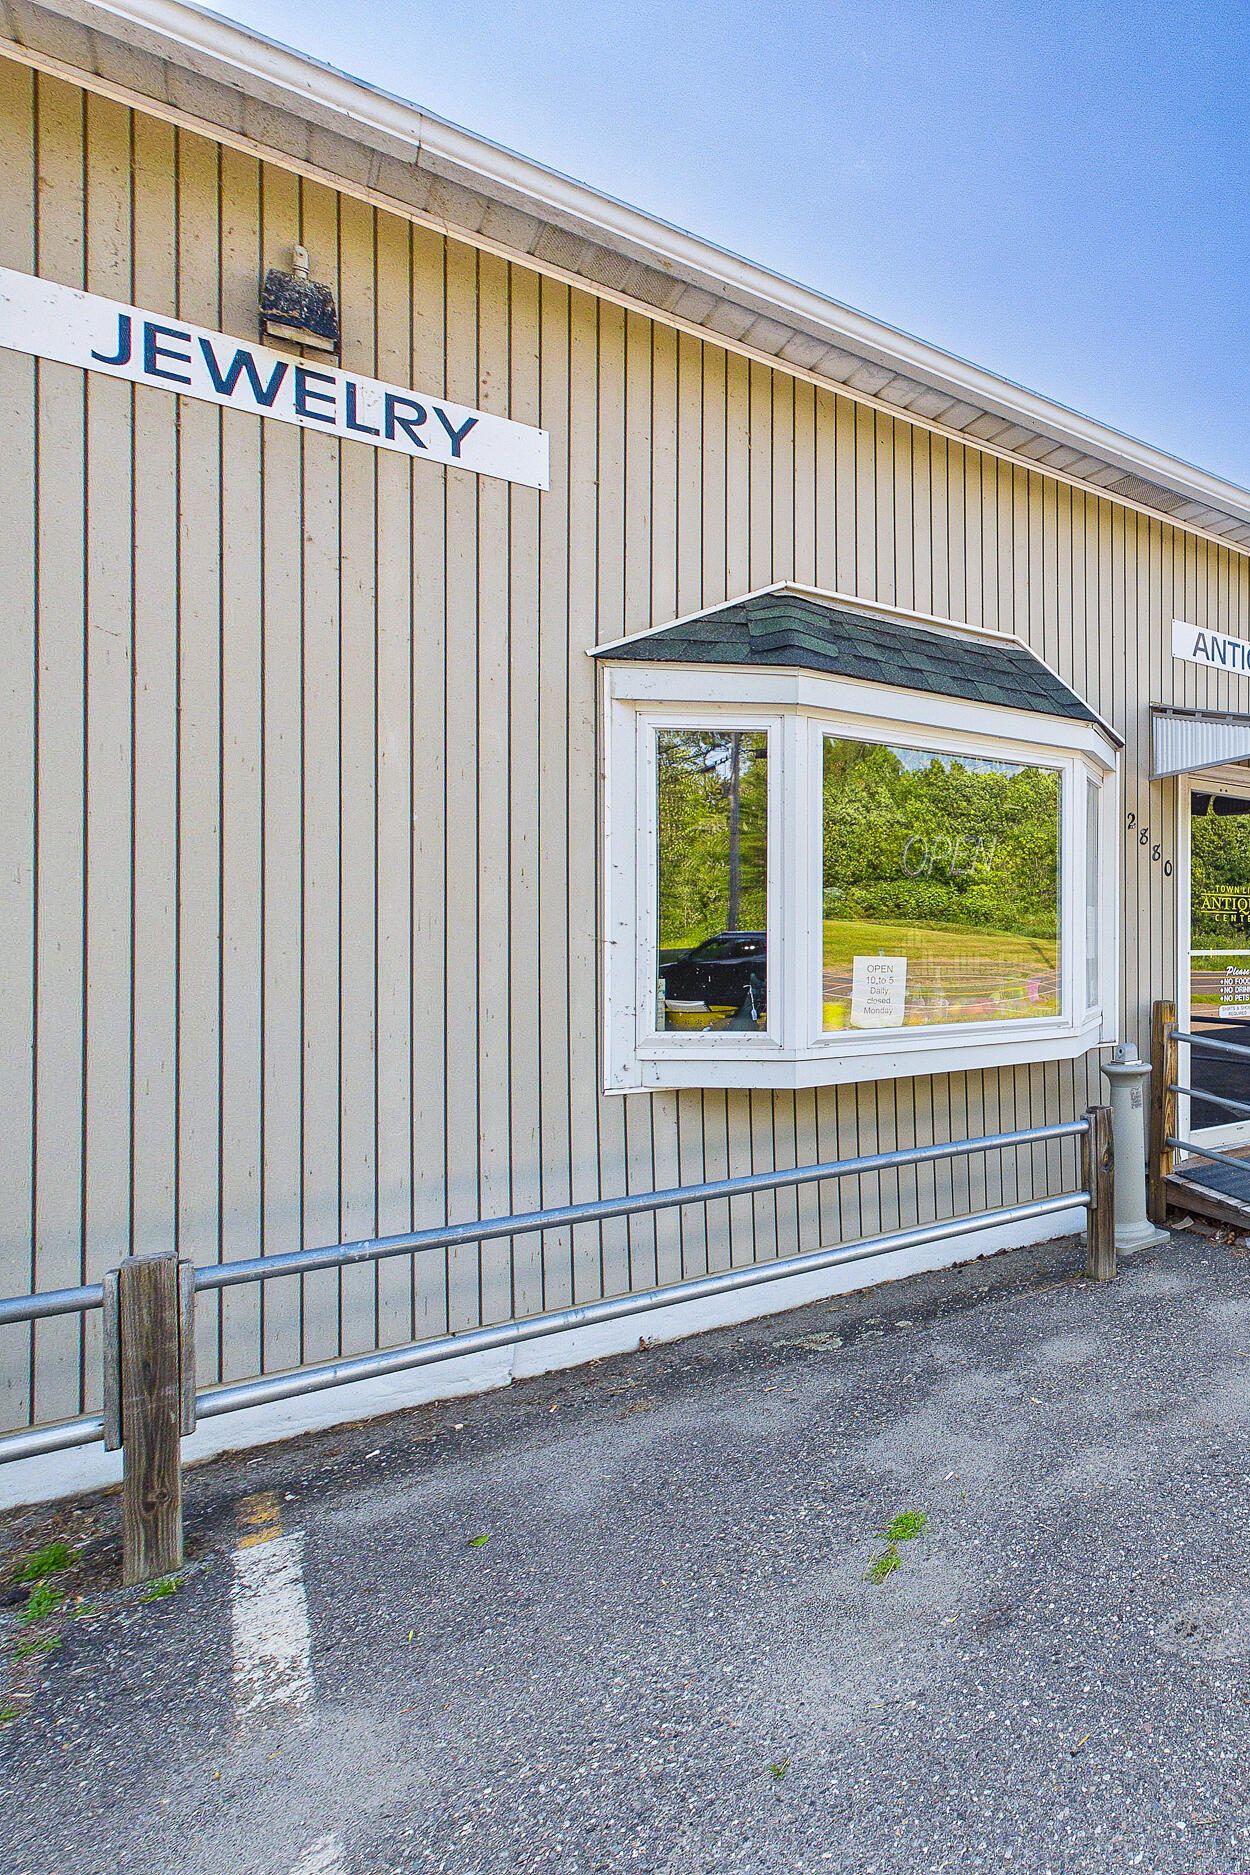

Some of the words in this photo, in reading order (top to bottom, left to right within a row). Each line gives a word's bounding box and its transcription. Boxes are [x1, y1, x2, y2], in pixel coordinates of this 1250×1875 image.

[90, 312, 480, 459] JEWELRY
[1127, 812, 1173, 877] 2880
[902, 834, 999, 879] OPEN
[1216, 884, 1240, 894] TOWN
[866, 964, 894, 974] OPEN
[1226, 965, 1250, 977] Please
[866, 976, 876, 985] 10
[878, 976, 887, 985] to
[888, 976, 895, 985] 5
[870, 986, 889, 996] Daily
[866, 997, 891, 1005] closed
[1223, 994, 1233, 1002] NO
[1234, 994, 1250, 1002] PETS
[863, 1006, 894, 1016] Monday
